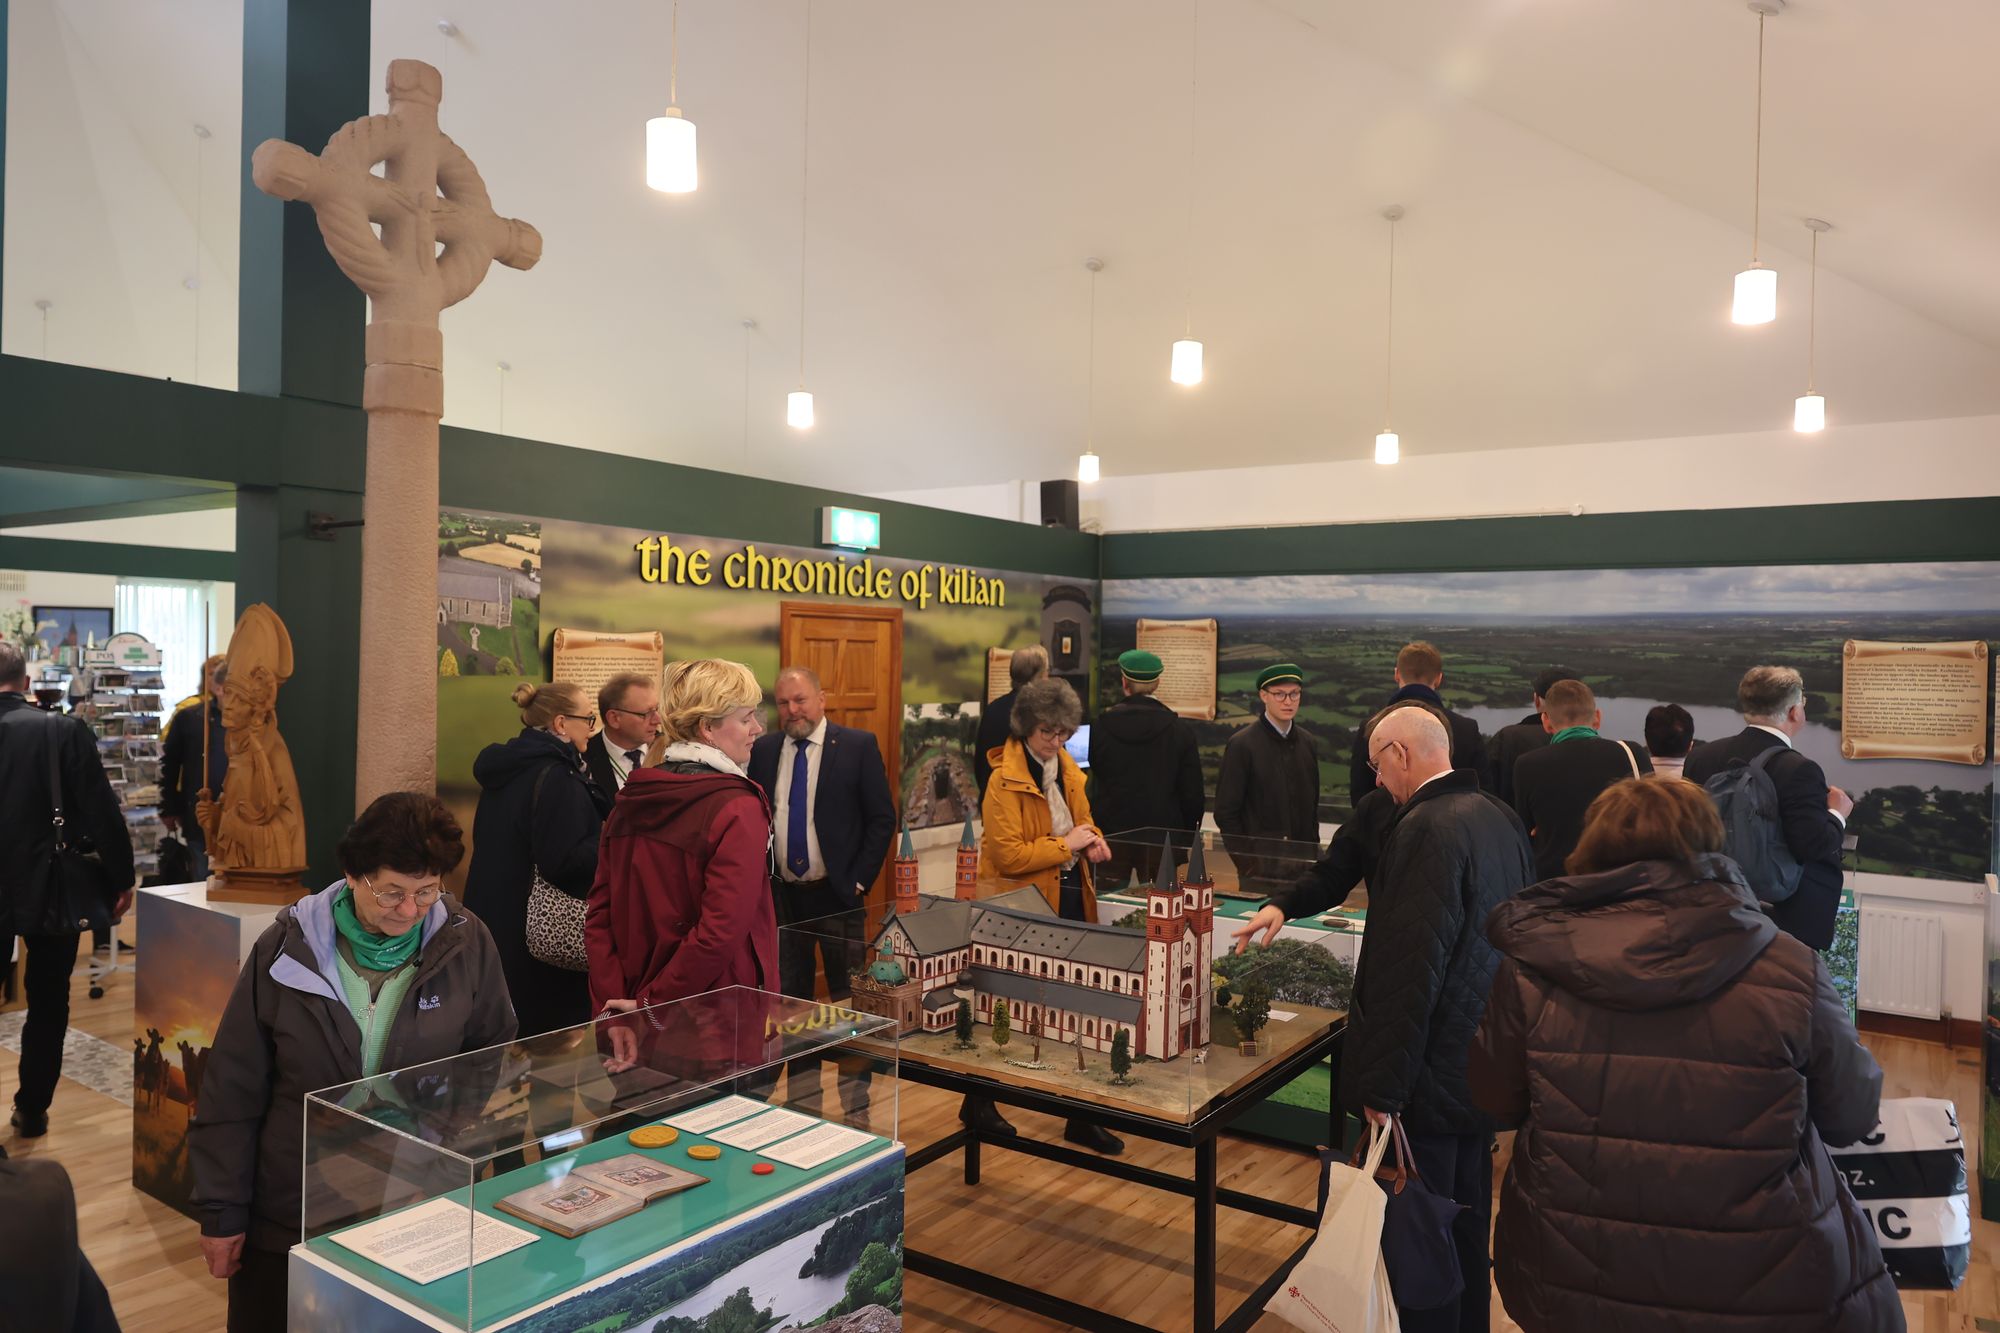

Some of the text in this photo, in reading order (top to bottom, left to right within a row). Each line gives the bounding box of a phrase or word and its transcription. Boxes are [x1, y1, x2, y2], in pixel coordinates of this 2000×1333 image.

[635, 535, 1005, 609] the chronicle of kilian
